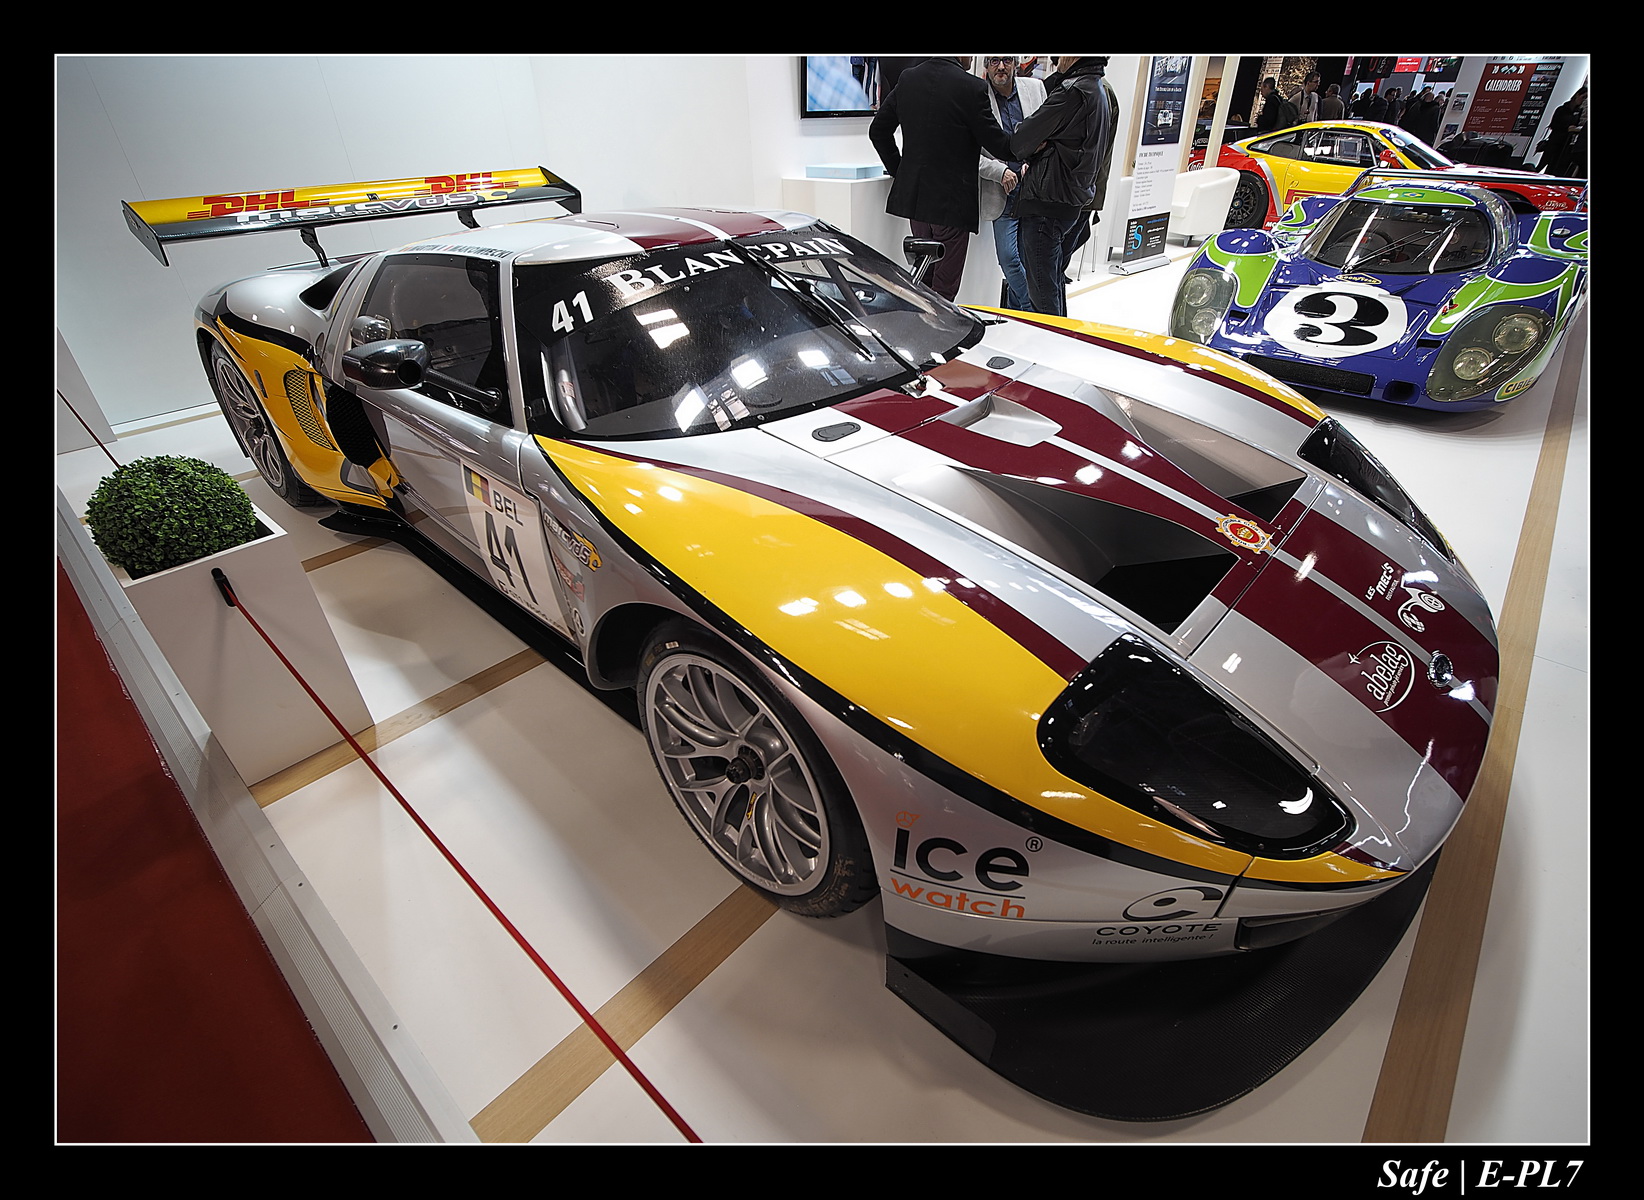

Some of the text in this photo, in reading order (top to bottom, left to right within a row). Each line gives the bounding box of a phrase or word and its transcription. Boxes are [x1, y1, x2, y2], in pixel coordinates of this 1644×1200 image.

[1485, 79, 1523, 92] CALENDRIER
[203, 189, 310, 218] DHL
[424, 172, 504, 195] DHL
[602, 237, 854, 299] BLANCPAIN
[551, 290, 594, 334] 41
[1293, 291, 1390, 346] 3
[493, 489, 524, 526] BEL
[484, 510, 539, 606] 41
[1365, 585, 1376, 601] LES
[1375, 562, 1395, 596] MEC'S
[1360, 643, 1409, 701] abelag
[893, 826, 1030, 892] ice
[890, 877, 1026, 919] watch
[1096, 923, 1223, 937] COYOTE
[1105, 937, 1138, 946] route
[1141, 933, 1207, 945] intelligente
